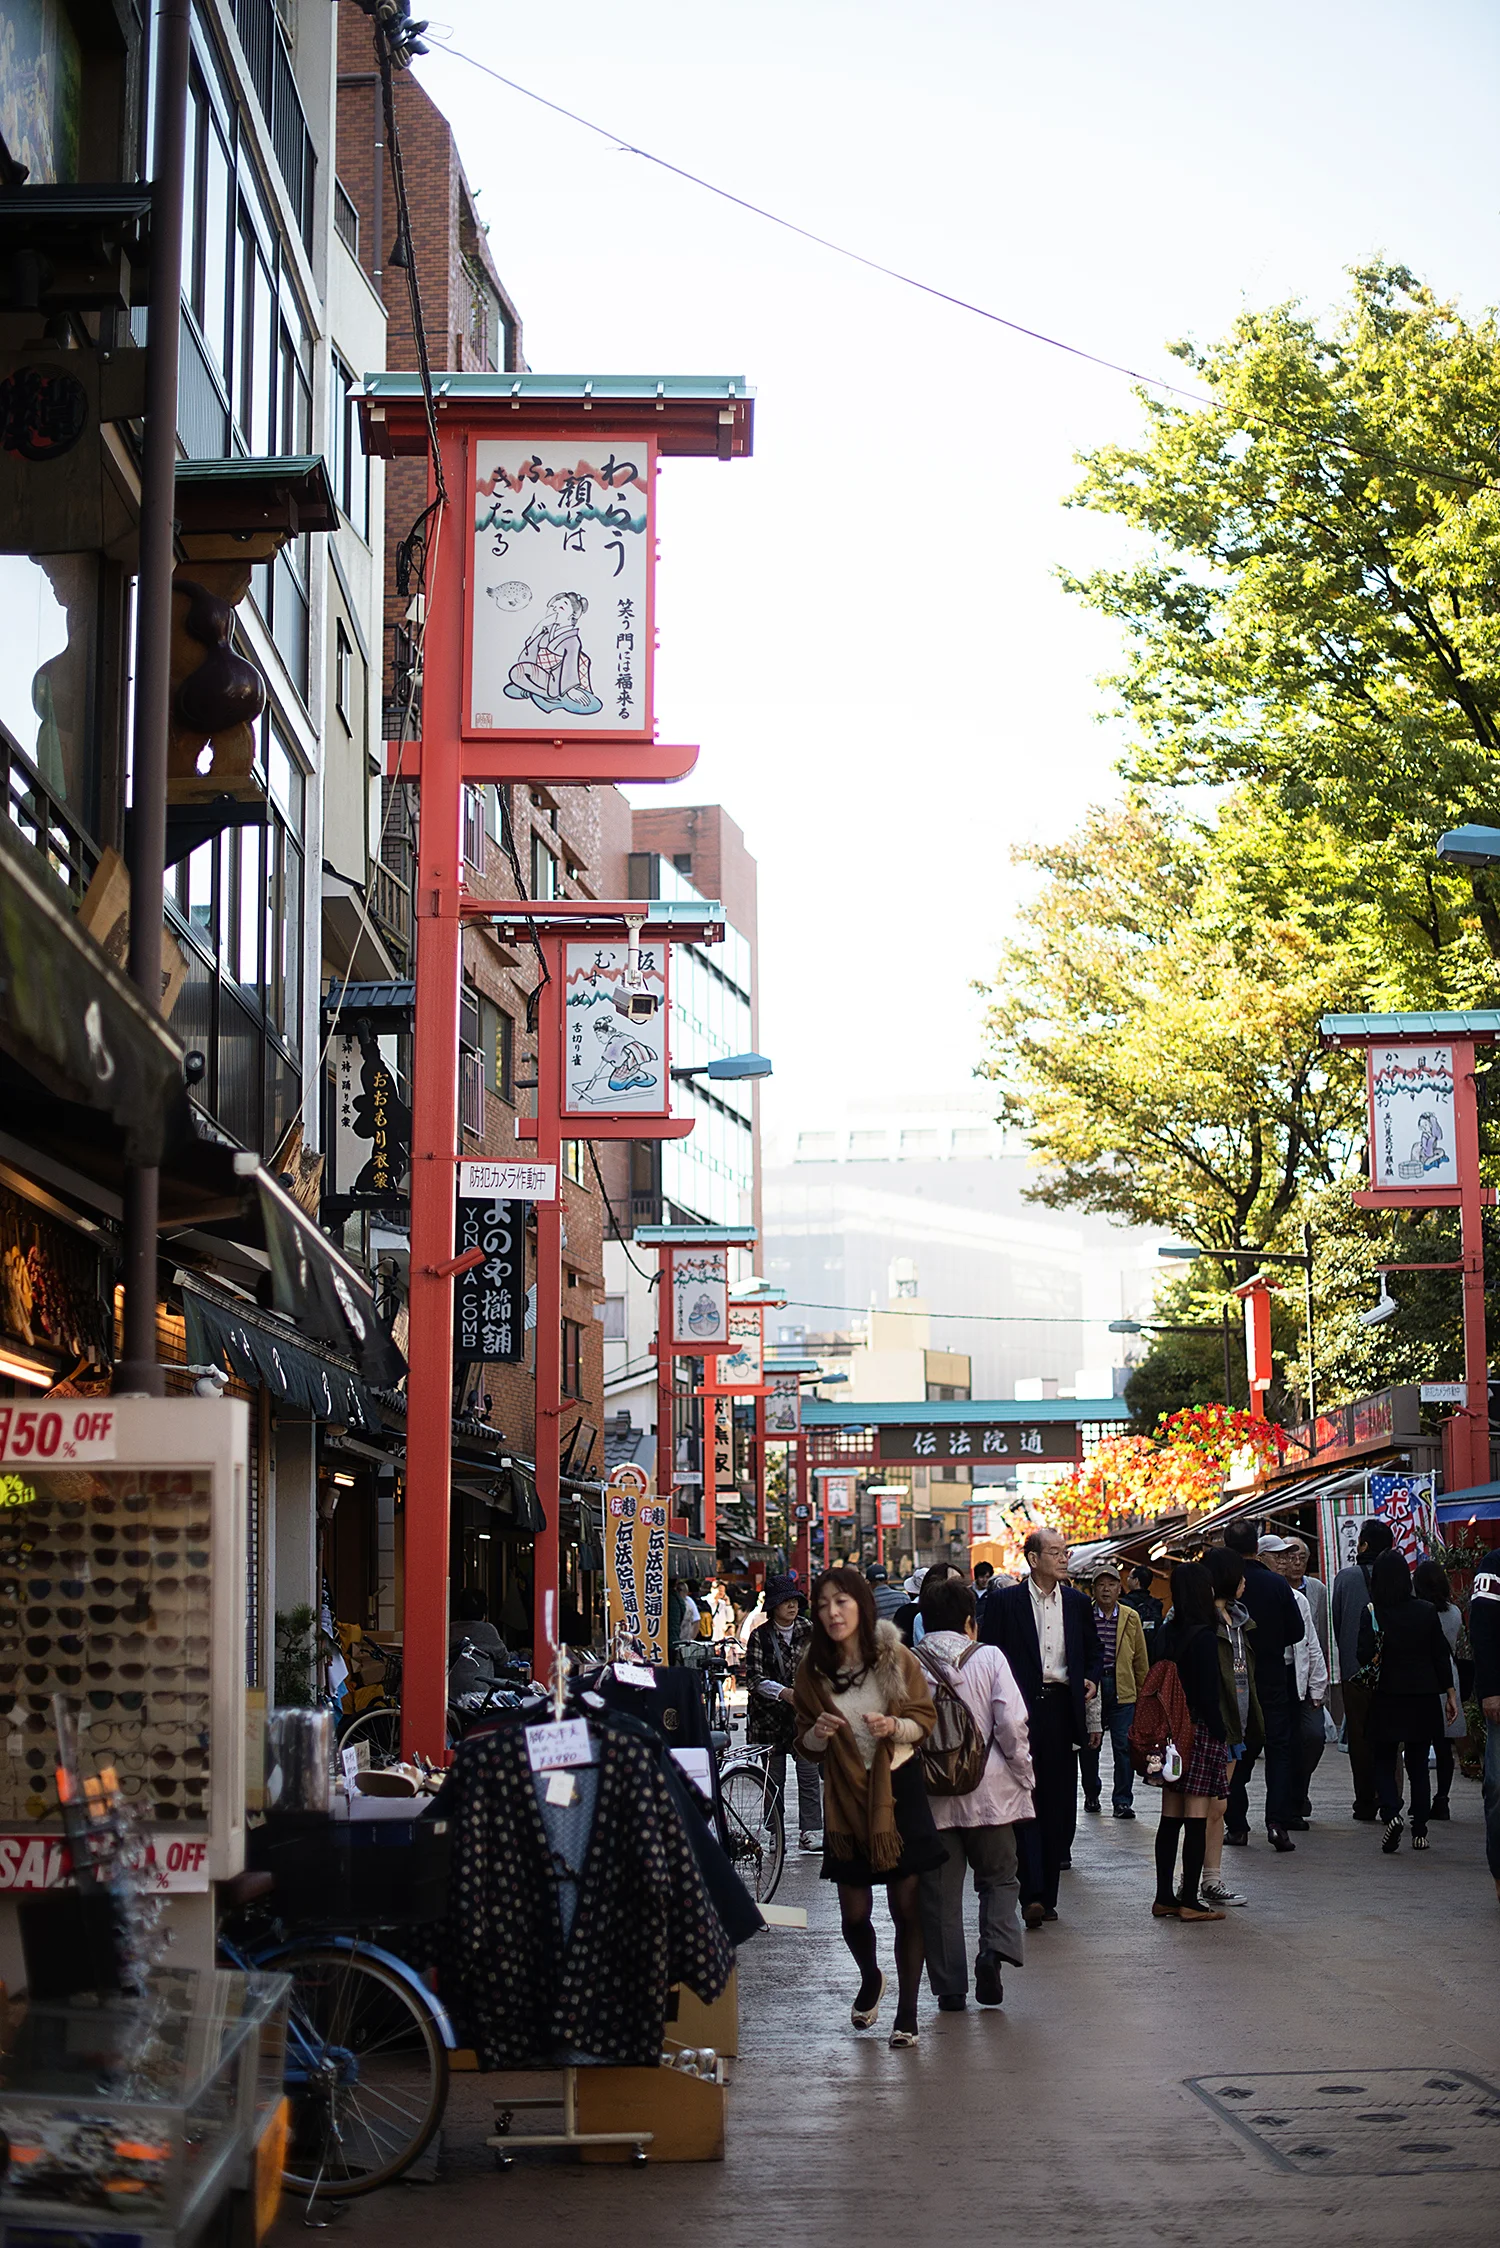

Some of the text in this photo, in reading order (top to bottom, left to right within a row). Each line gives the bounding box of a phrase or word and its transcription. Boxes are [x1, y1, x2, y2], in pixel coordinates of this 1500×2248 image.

[489, 467, 513, 557] きたる
[518, 455, 555, 533] ふぐ
[557, 470, 594, 552] 顔には
[601, 454, 639, 577] わらう
[615, 598, 635, 720] 笑う門には福来る
[572, 950, 616, 1011] むすめ
[571, 1022, 583, 1066] 舌切り雀
[469, 1165, 546, 1190] 防犯カメラ作動中
[462, 1207, 478, 1347] YONA COMB
[73, 1412, 113, 1440] OFF
[912, 1428, 1044, 1456] 伝法院通
[166, 1842, 206, 1872] OFF
